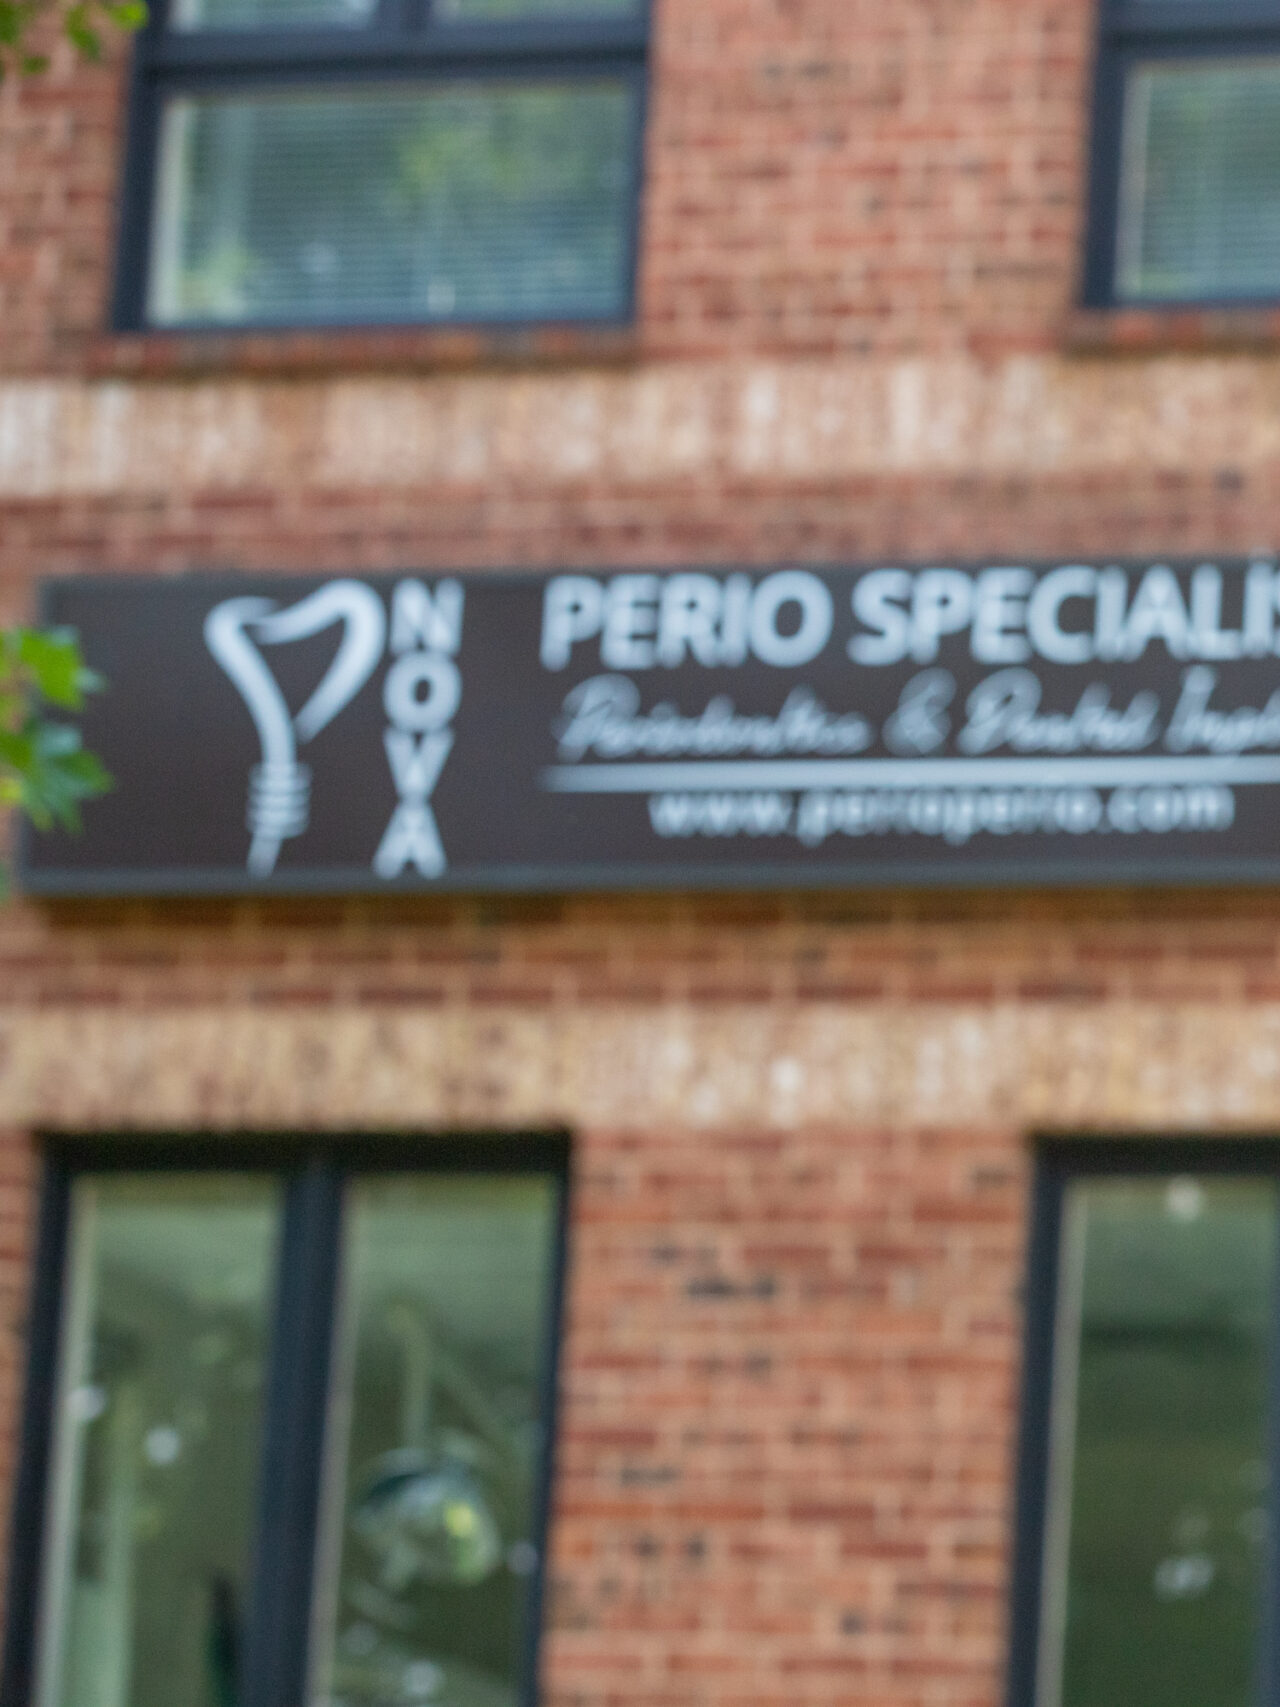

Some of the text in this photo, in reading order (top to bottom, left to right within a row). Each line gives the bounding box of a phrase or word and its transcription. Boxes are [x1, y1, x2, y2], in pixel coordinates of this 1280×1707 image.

[540, 569, 834, 671] PERIO
[372, 577, 465, 879] NOVA
[881, 667, 957, 757] &
[648, 786, 1235, 846] www.perioperio.com
